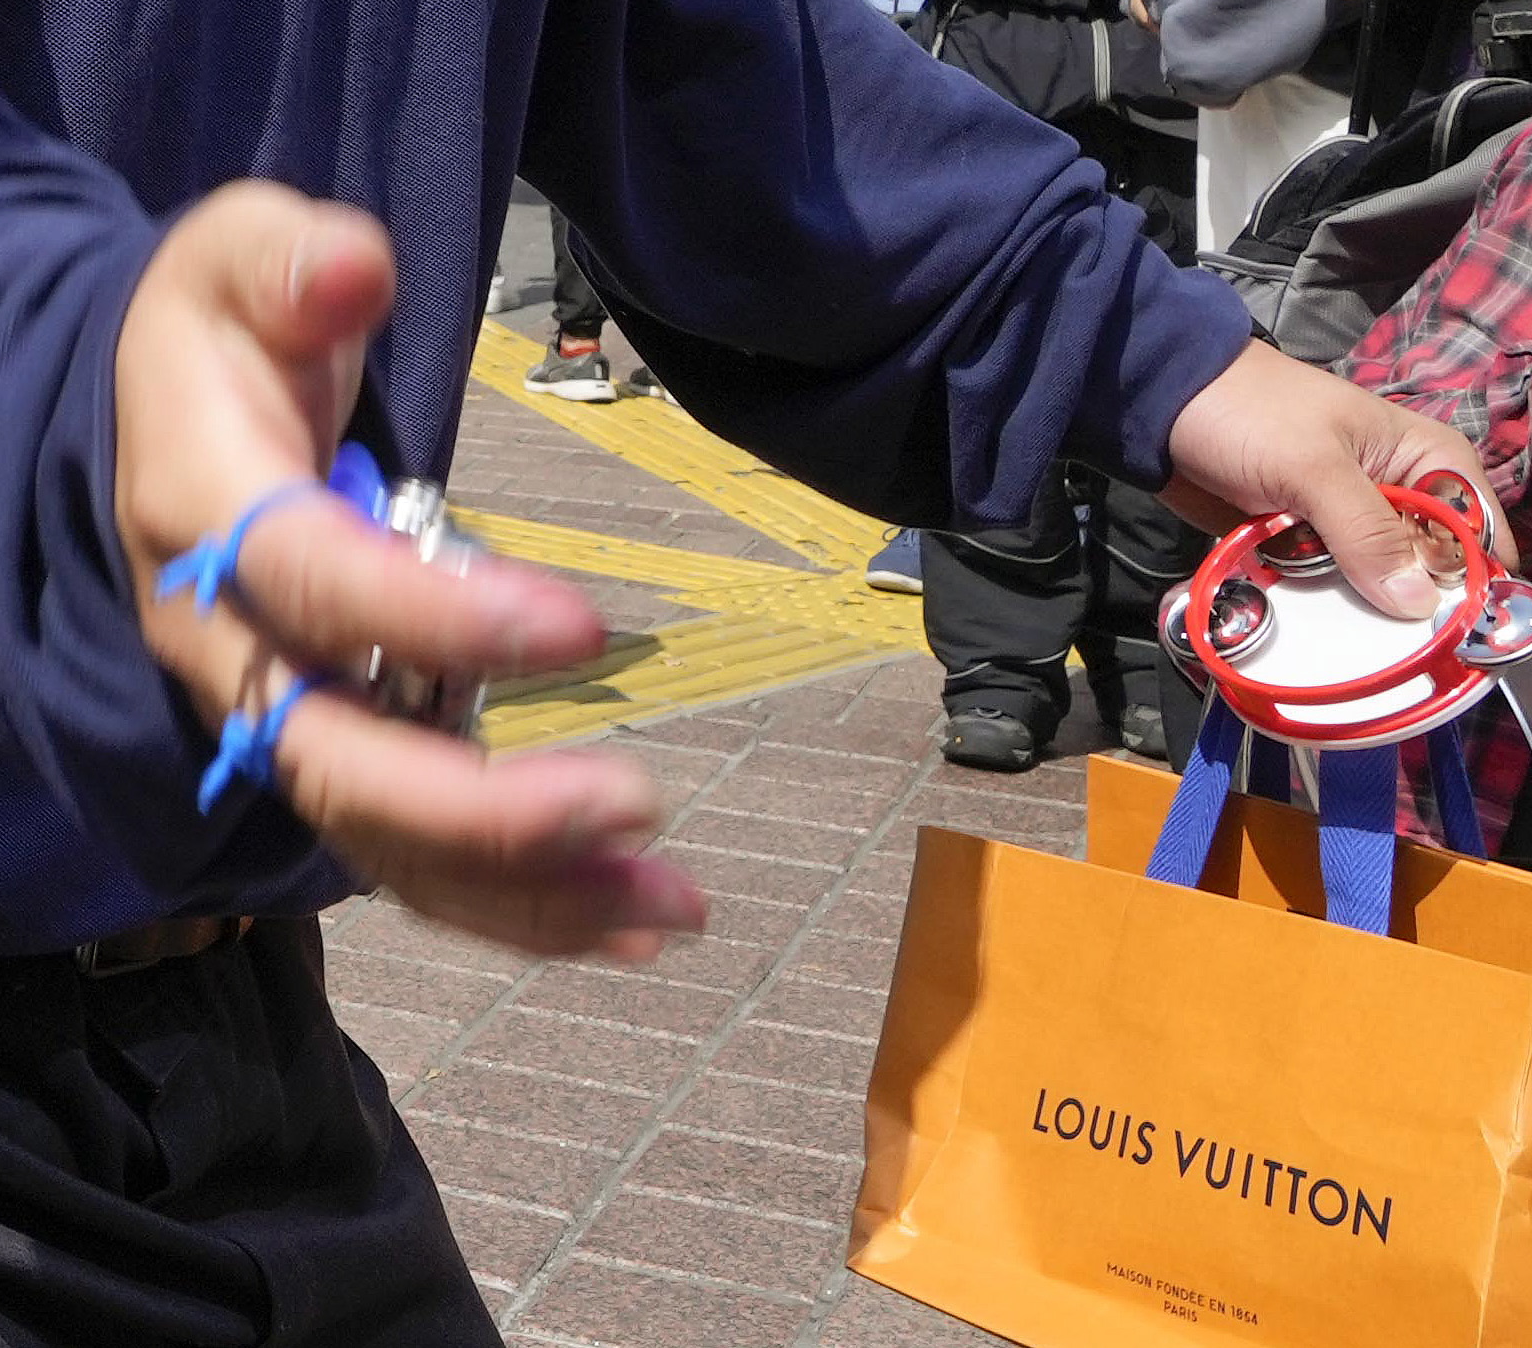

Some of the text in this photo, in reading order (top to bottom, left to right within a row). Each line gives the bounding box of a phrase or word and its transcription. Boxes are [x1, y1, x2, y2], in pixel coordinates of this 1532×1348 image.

[1033, 1088, 1392, 1246] LOUIS VUITTON
[1106, 1262, 1152, 1290] MAISON
[1209, 1296, 1226, 1314] EN
[1231, 1304, 1259, 1326] 1854
[1163, 1300, 1199, 1324] PARIS
